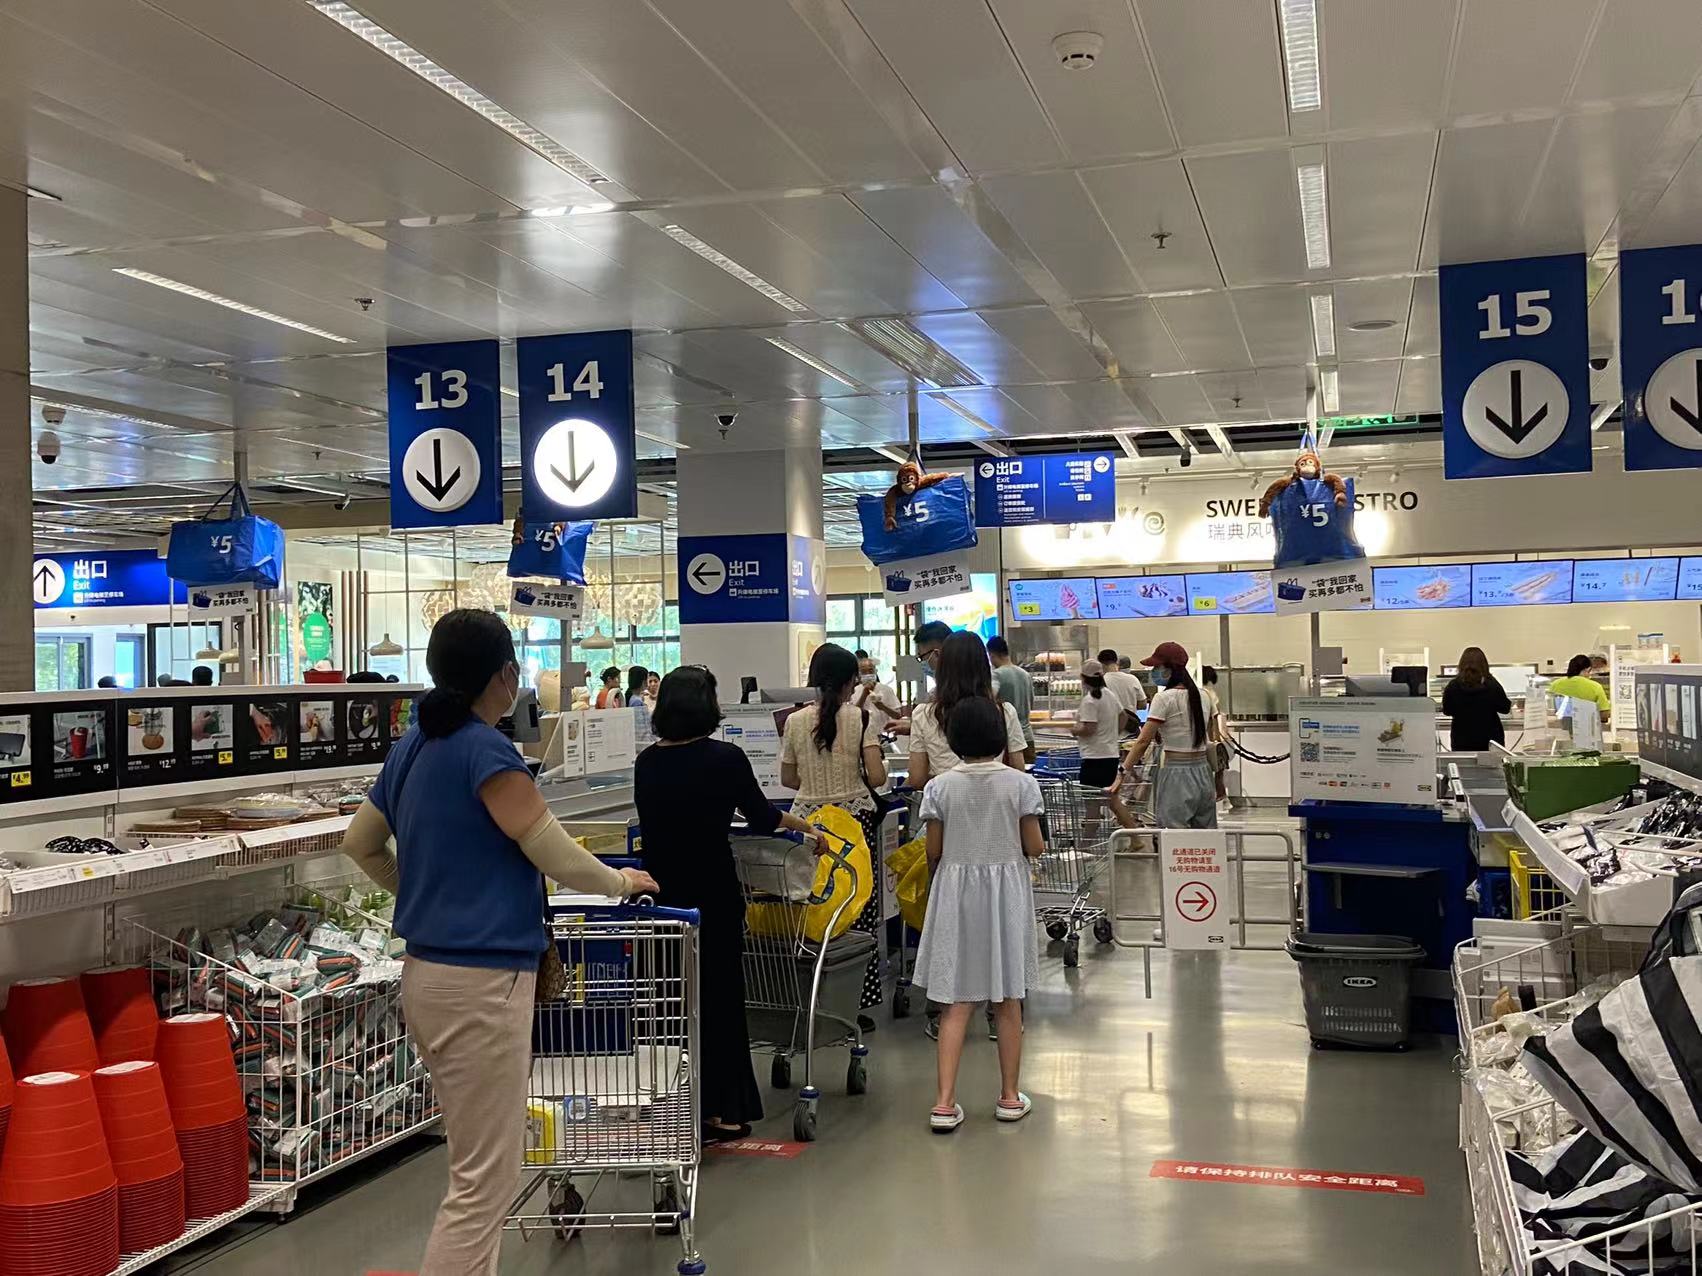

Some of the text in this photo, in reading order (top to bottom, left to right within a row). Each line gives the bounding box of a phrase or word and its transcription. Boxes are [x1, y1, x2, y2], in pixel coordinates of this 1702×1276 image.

[1661, 279, 1702, 325] 1
[1477, 290, 1552, 339] 15
[414, 370, 468, 410] 13
[546, 360, 603, 402] 14
[996, 461, 1022, 475] 出口
[903, 501, 930, 522] ¥5
[1206, 491, 1418, 517] SWE STRO
[1300, 503, 1329, 527] ¥5
[210, 535, 232, 553] ¥5
[535, 529, 556, 552] ¥5
[73, 559, 108, 579] 出口
[728, 560, 759, 577] 出口
[73, 580, 90, 590] Exit
[728, 578, 745, 586] Exit
[914, 573, 963, 589] 买再多都不怕
[1308, 583, 1364, 599] 买再多都不怕
[1172, 848, 1216, 856] 此通道已关闭
[1176, 856, 1213, 864] 无购物请至
[1175, 1165, 1398, 1188] 请保持排队安全距离
